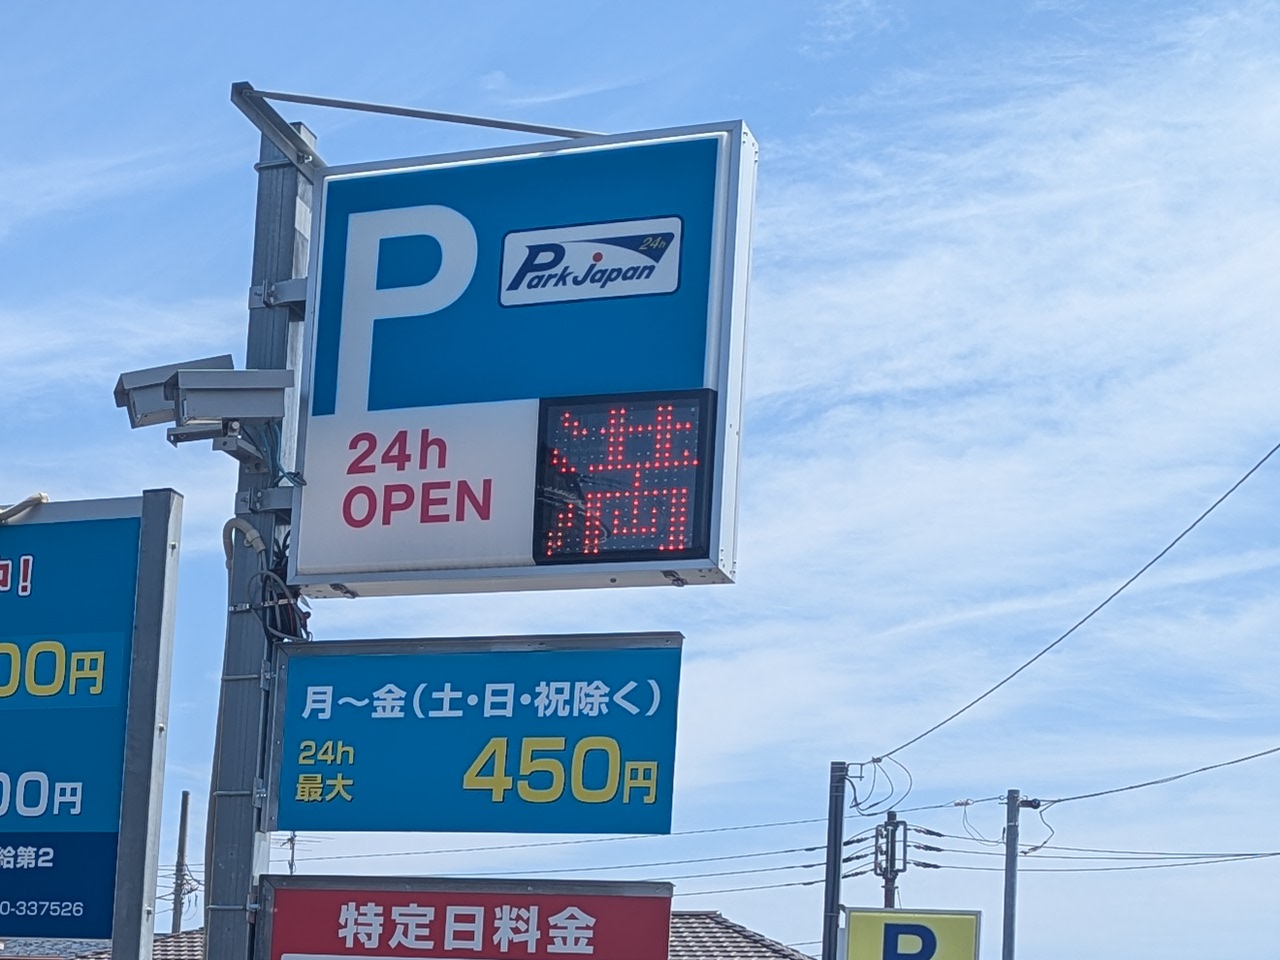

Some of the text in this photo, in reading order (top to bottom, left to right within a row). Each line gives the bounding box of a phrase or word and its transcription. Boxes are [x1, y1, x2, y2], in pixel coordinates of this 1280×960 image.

[638, 235, 667, 251] 24h
[333, 204, 478, 415] P
[346, 429, 448, 475] 24h
[342, 478, 493, 528] OPEN
[545, 405, 700, 556] 満
[298, 739, 355, 766] 24h
[462, 735, 658, 805] 450円
[295, 773, 354, 802] 最大
[337, 902, 597, 955] 特定日料金
